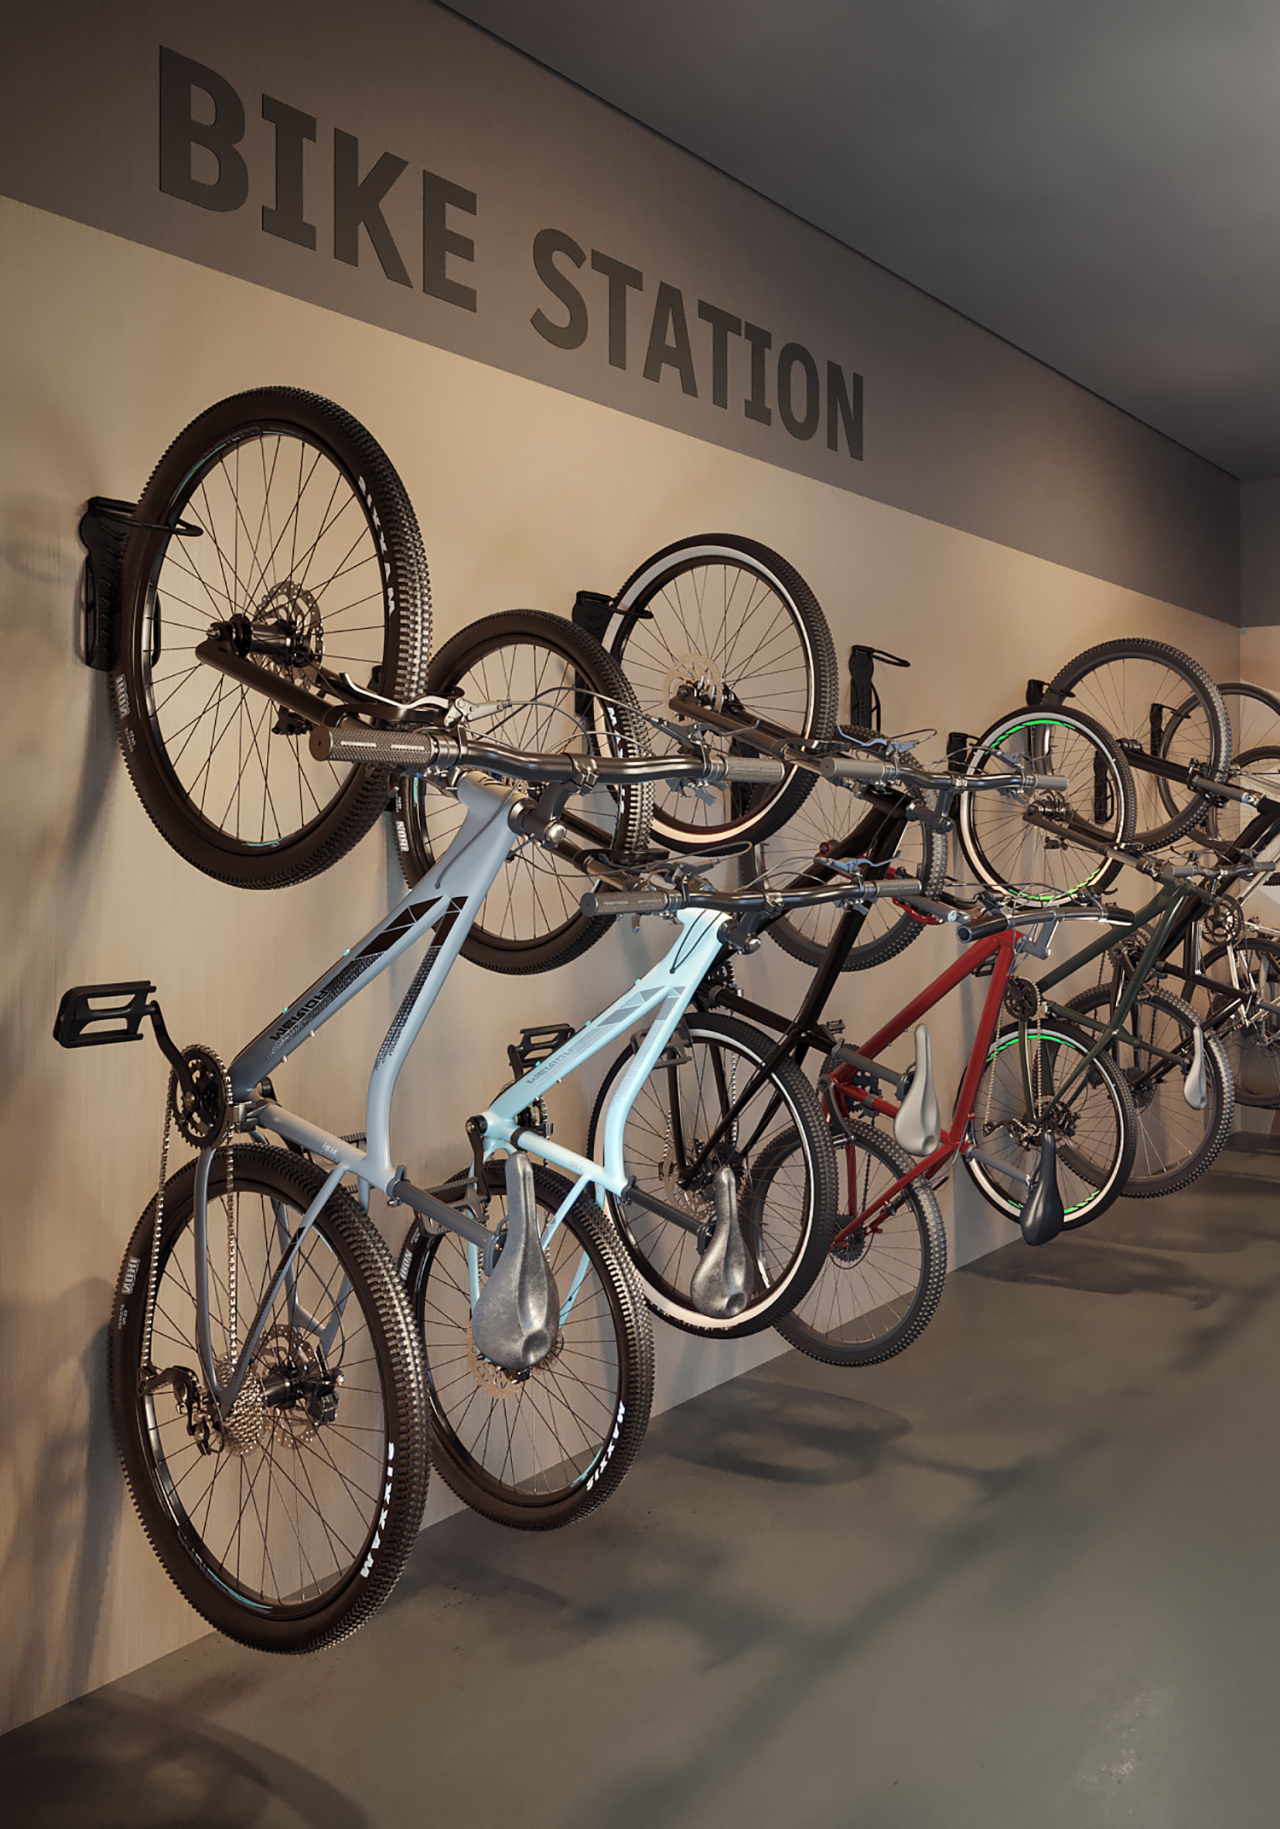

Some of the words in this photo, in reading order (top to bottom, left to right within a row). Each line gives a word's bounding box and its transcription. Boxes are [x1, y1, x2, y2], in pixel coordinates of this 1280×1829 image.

[159, 45, 478, 313] BIKE
[529, 228, 864, 462] STATION
[607, 707, 625, 814] MAIS
[586, 1400, 626, 1491] MAXXIS
